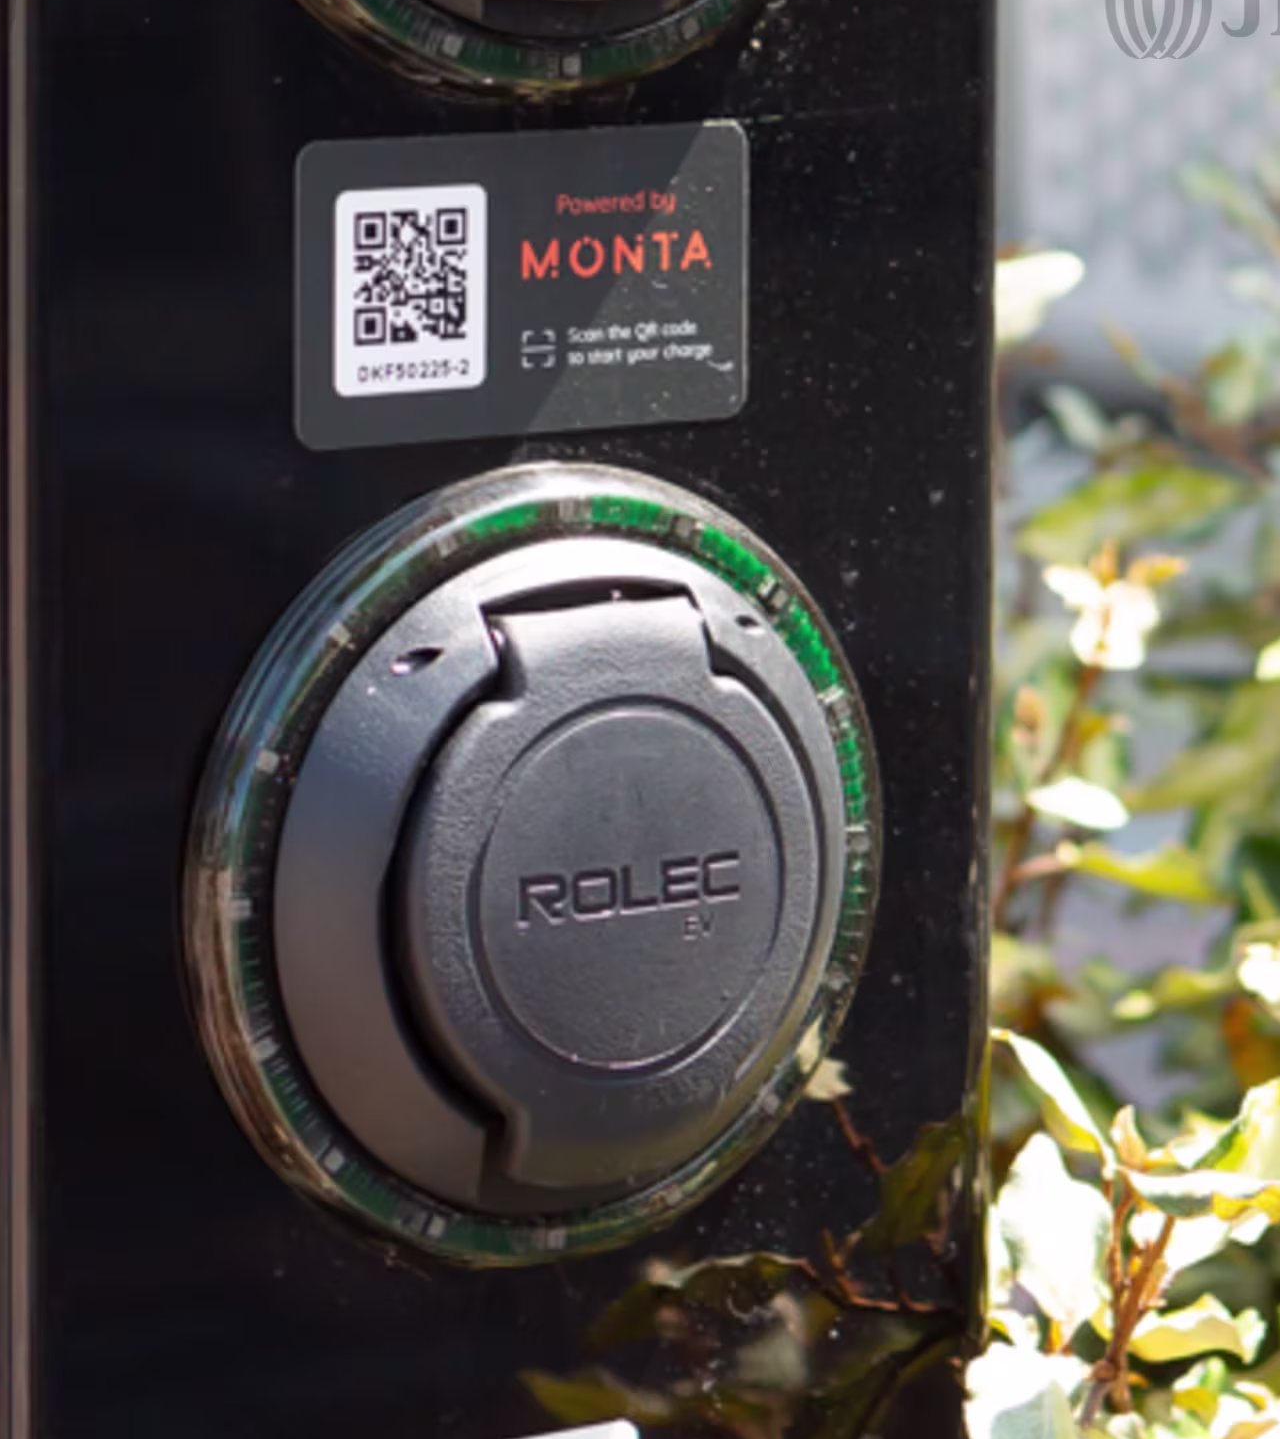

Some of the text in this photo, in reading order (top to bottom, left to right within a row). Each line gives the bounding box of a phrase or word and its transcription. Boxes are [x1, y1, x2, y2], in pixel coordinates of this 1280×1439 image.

[556, 189, 677, 216] Powered by
[521, 229, 712, 281] MONTA
[567, 319, 698, 343] Scan the QR code
[587, 348, 622, 365] start
[626, 347, 659, 366] your
[662, 342, 713, 361] charge
[515, 850, 740, 930] ROLEC
[682, 913, 713, 941] EV
